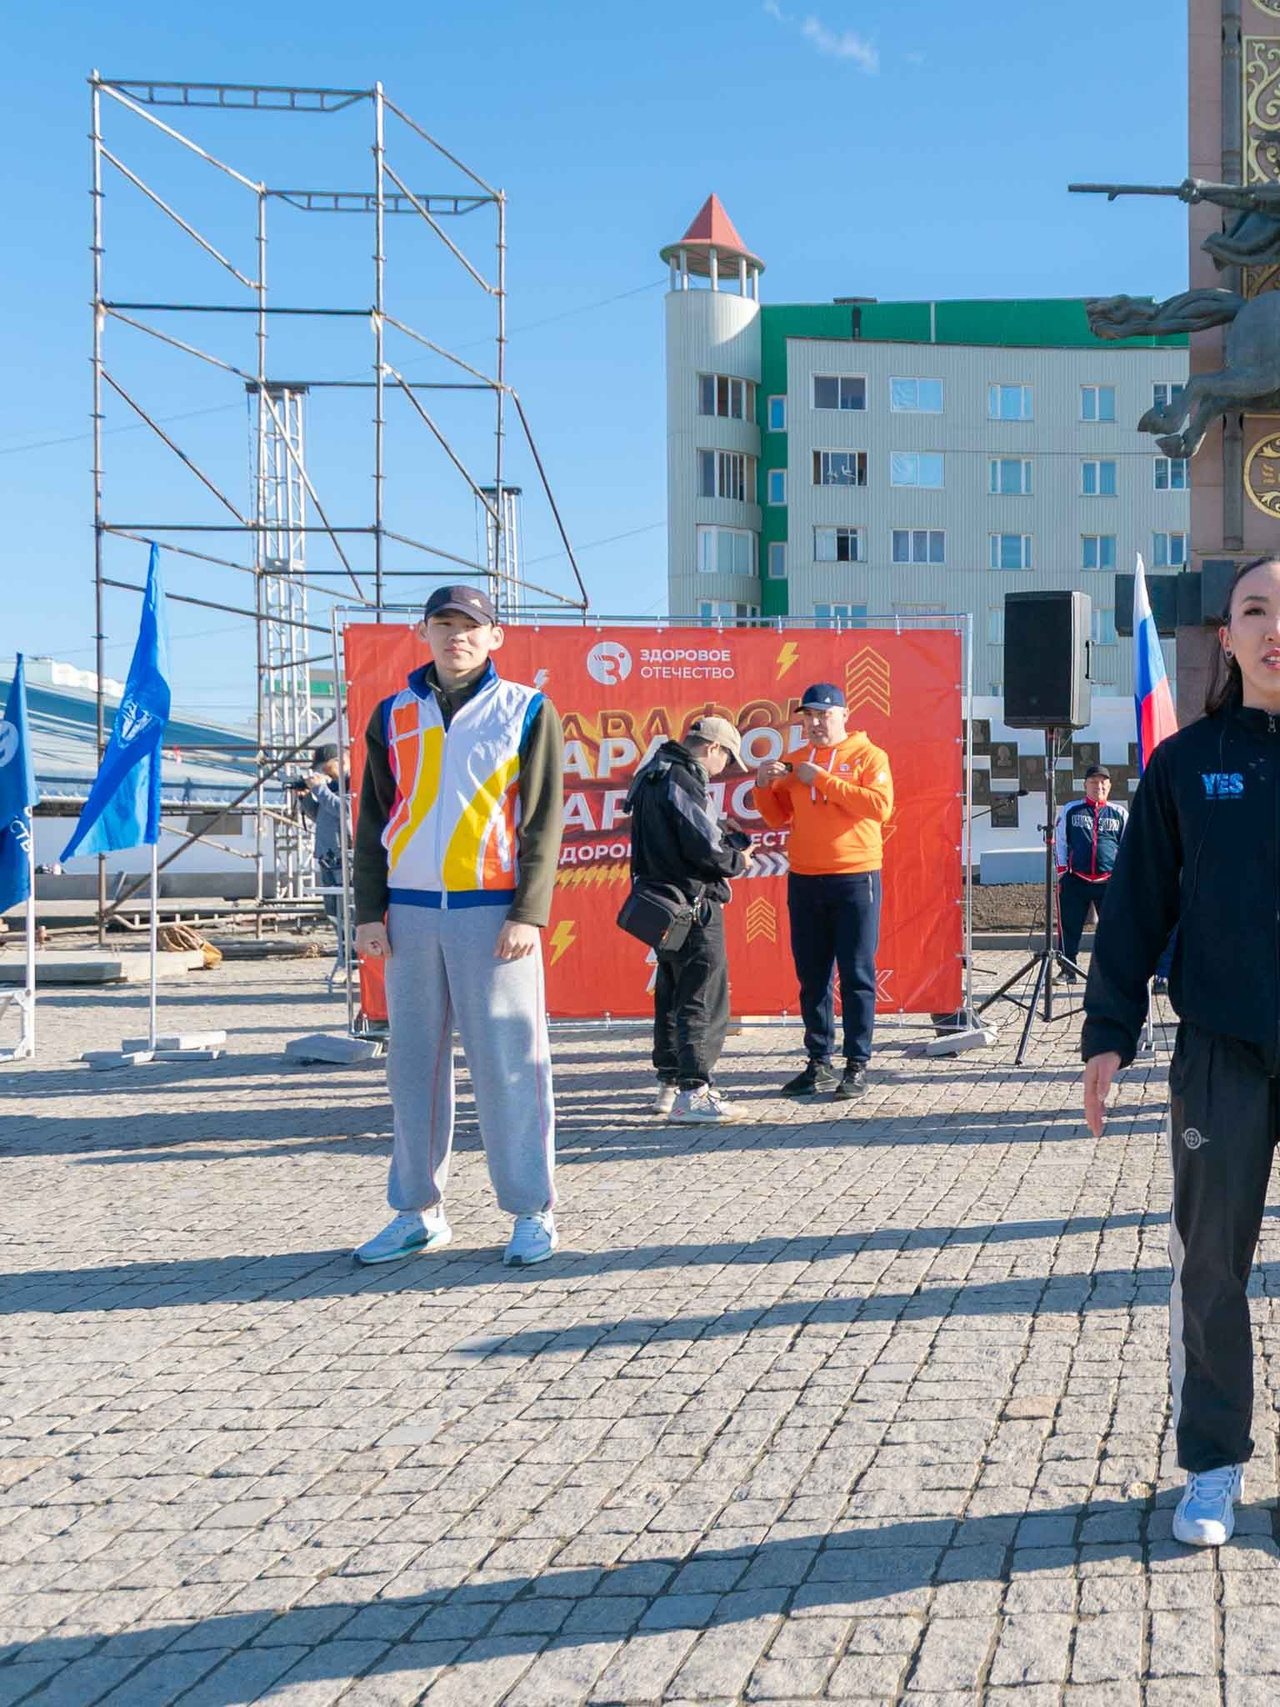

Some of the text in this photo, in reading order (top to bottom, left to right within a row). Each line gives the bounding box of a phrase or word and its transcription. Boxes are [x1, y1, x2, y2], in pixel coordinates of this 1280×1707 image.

[640, 649, 731, 663] ЗДОРОВОЕ
[640, 666, 735, 680] ОТЕЧЕСТВО
[1201, 773, 1244, 794] YES
